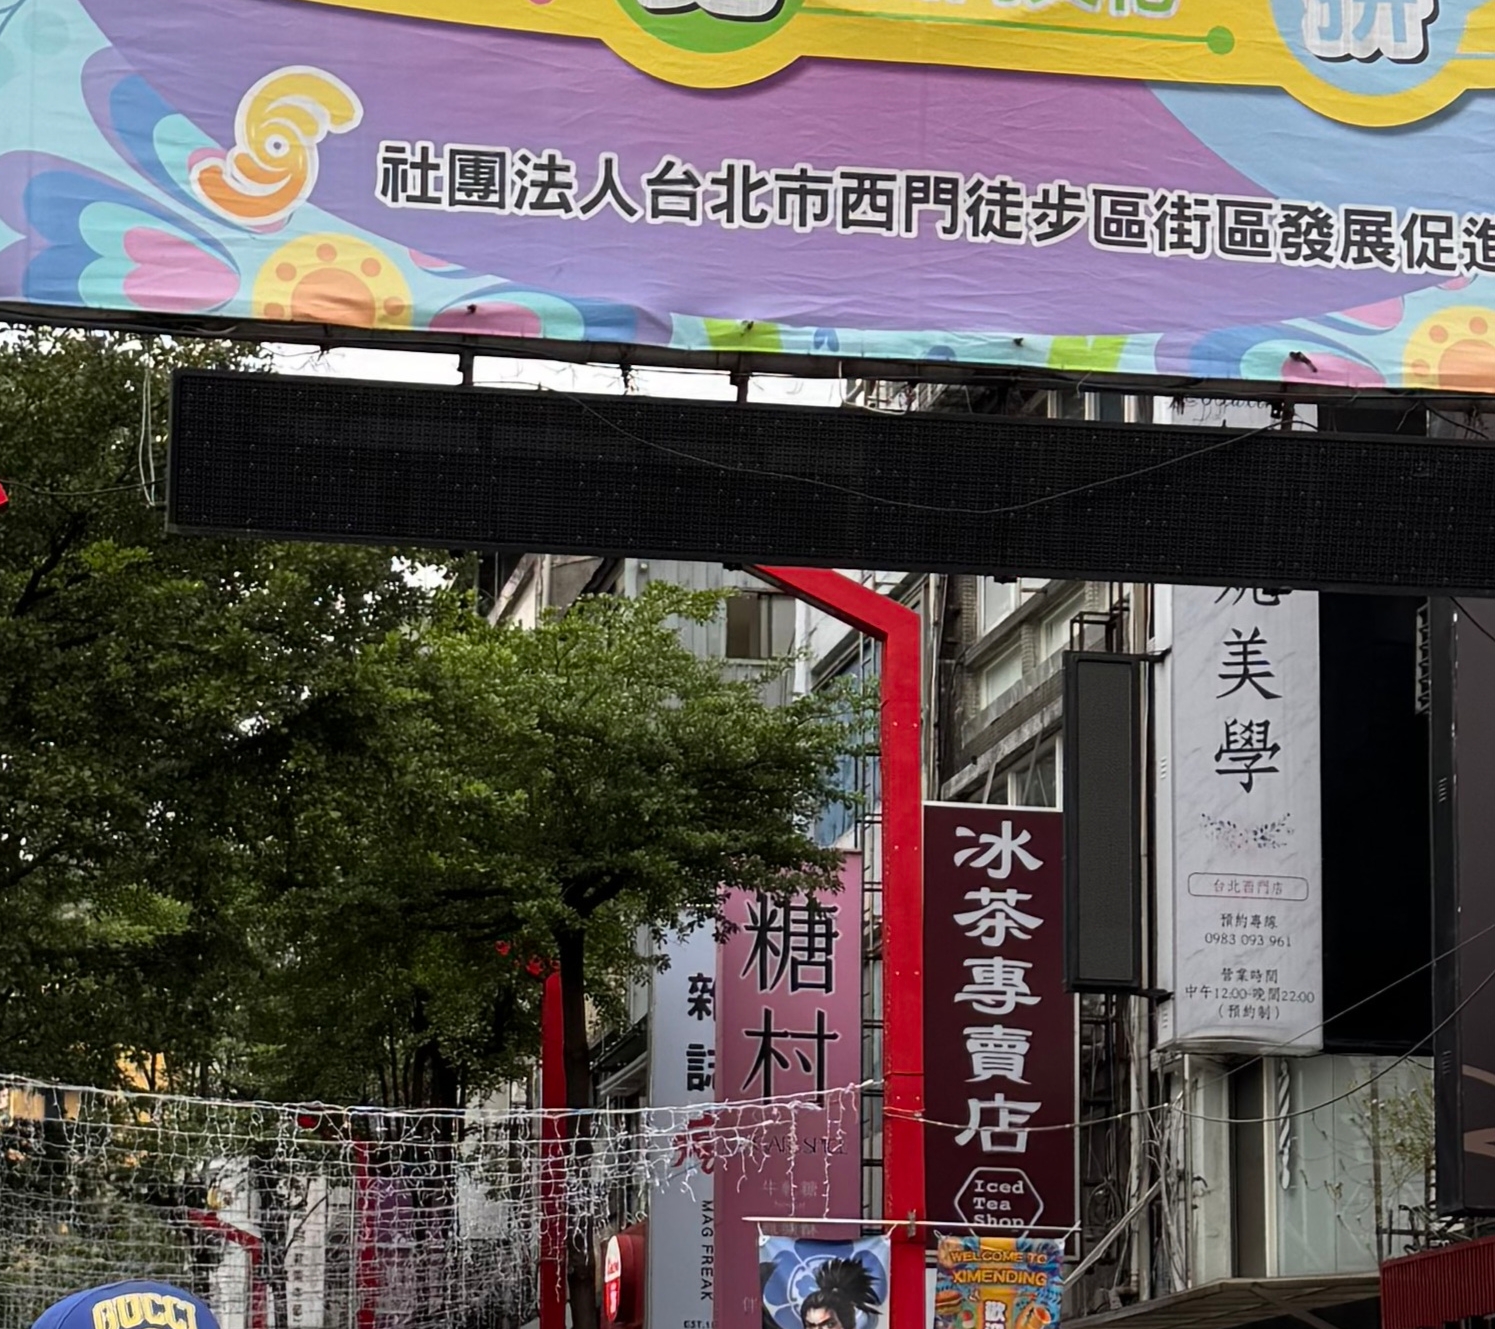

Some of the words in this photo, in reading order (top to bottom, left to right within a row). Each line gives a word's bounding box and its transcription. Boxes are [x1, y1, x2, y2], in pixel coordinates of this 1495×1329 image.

[1215, 585, 1282, 793] 美學
[1205, 932, 1236, 946] 0983
[1241, 934, 1264, 946] 093
[1270, 936, 1291, 947] 961
[953, 820, 1044, 1153] 冰茶專賣店
[741, 892, 841, 1104] 糖村
[974, 1180, 1024, 1194] Iced
[973, 1197, 1011, 1210] Tea
[701, 1200, 714, 1237] MAG
[974, 1214, 1024, 1232] Shop
[951, 1250, 1023, 1262] WELCOME
[1028, 1252, 1048, 1264] TO
[701, 1244, 714, 1301] FREAK
[952, 1269, 1048, 1287] XIMENDING
